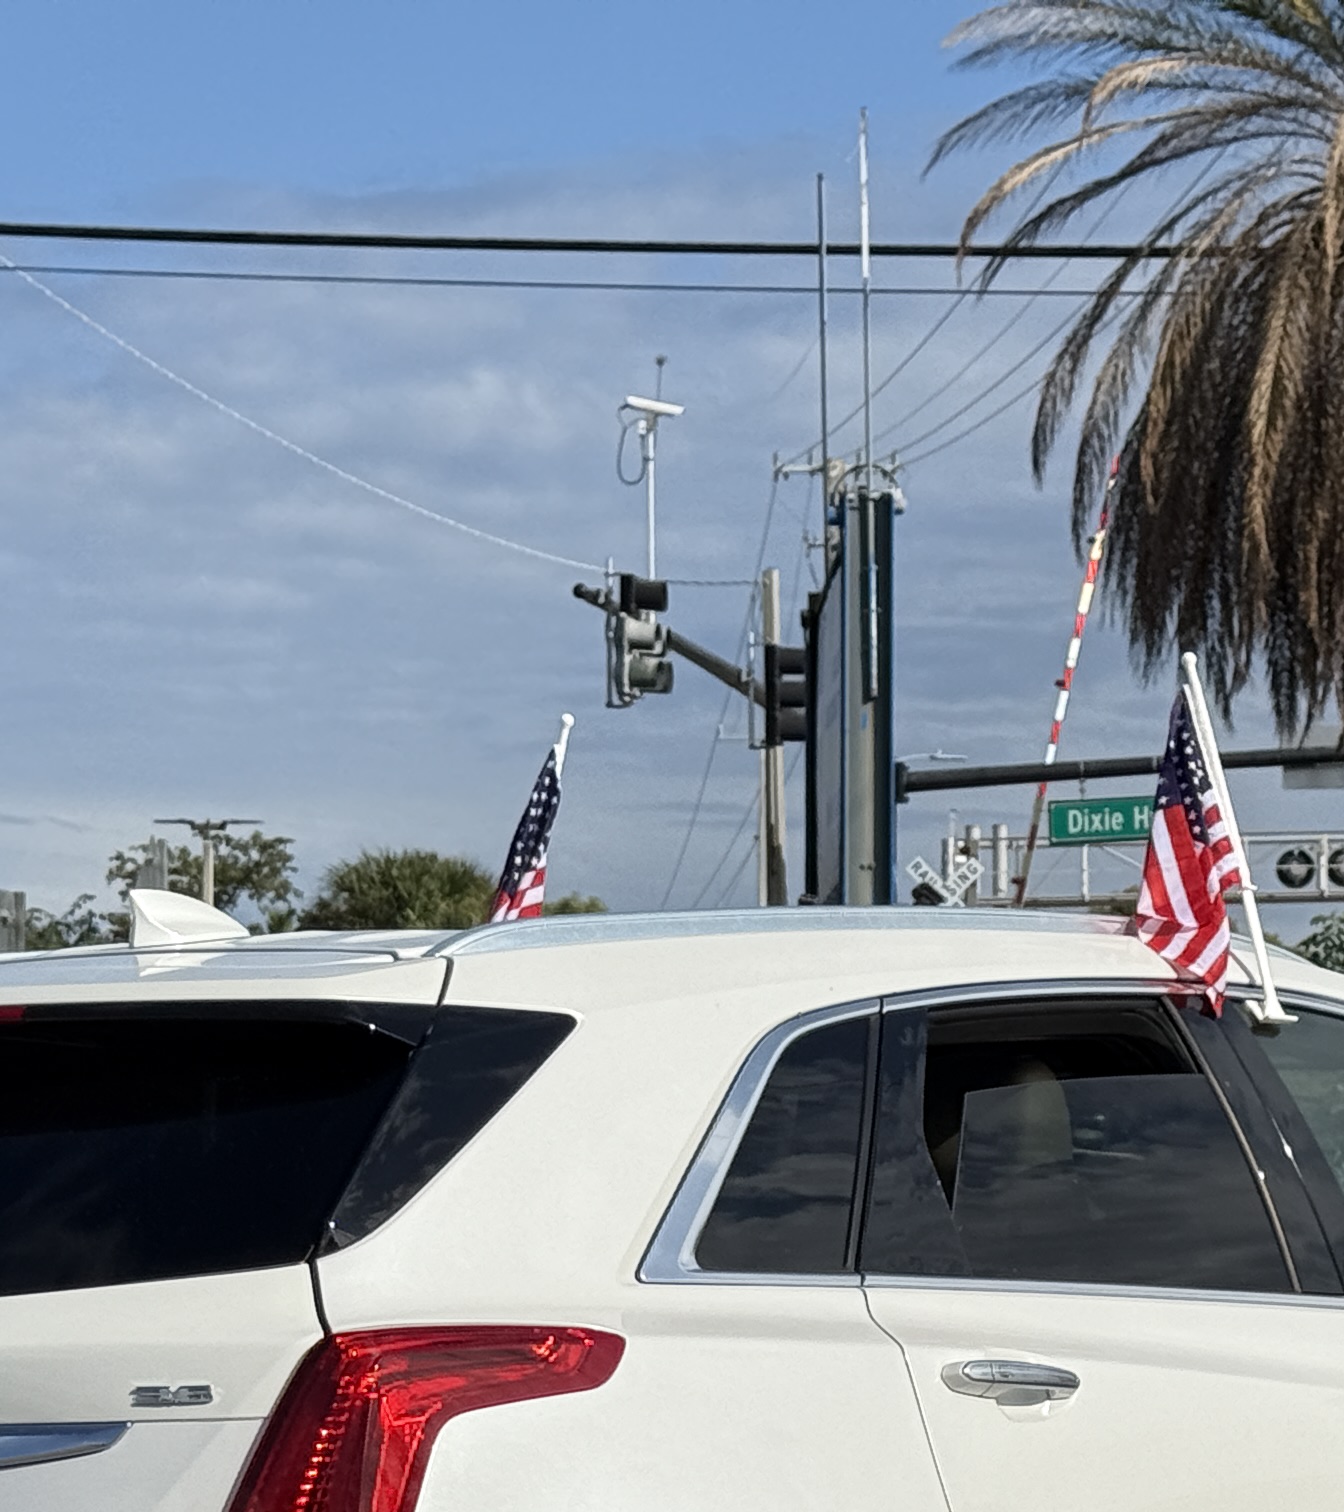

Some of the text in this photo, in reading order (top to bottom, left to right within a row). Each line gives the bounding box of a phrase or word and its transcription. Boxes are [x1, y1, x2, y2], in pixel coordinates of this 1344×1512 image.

[1067, 804, 1153, 834] Dixie H
[941, 862, 979, 898] SING
